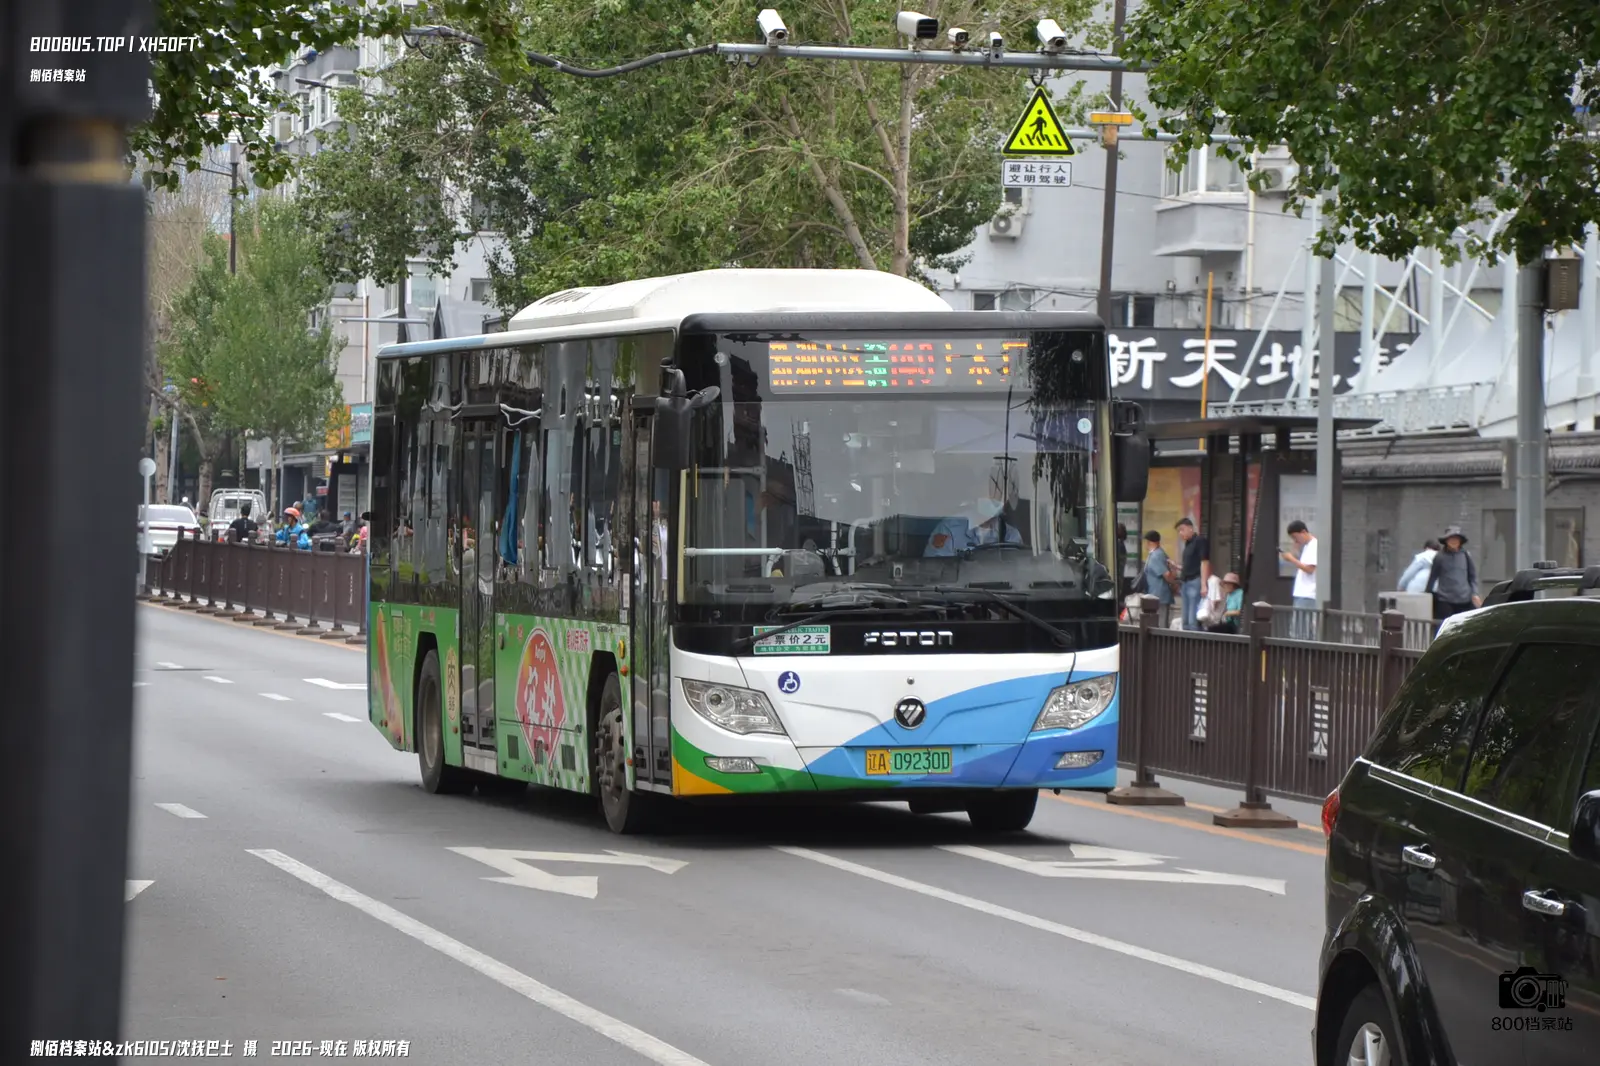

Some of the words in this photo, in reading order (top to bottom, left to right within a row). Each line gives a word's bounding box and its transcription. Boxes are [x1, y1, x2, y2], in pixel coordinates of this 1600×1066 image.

[1008, 164, 1066, 174] 避让行人
[1008, 174, 1066, 184] 文明驾驶
[775, 634, 826, 645] 票价2元
[864, 631, 954, 646] FOTON
